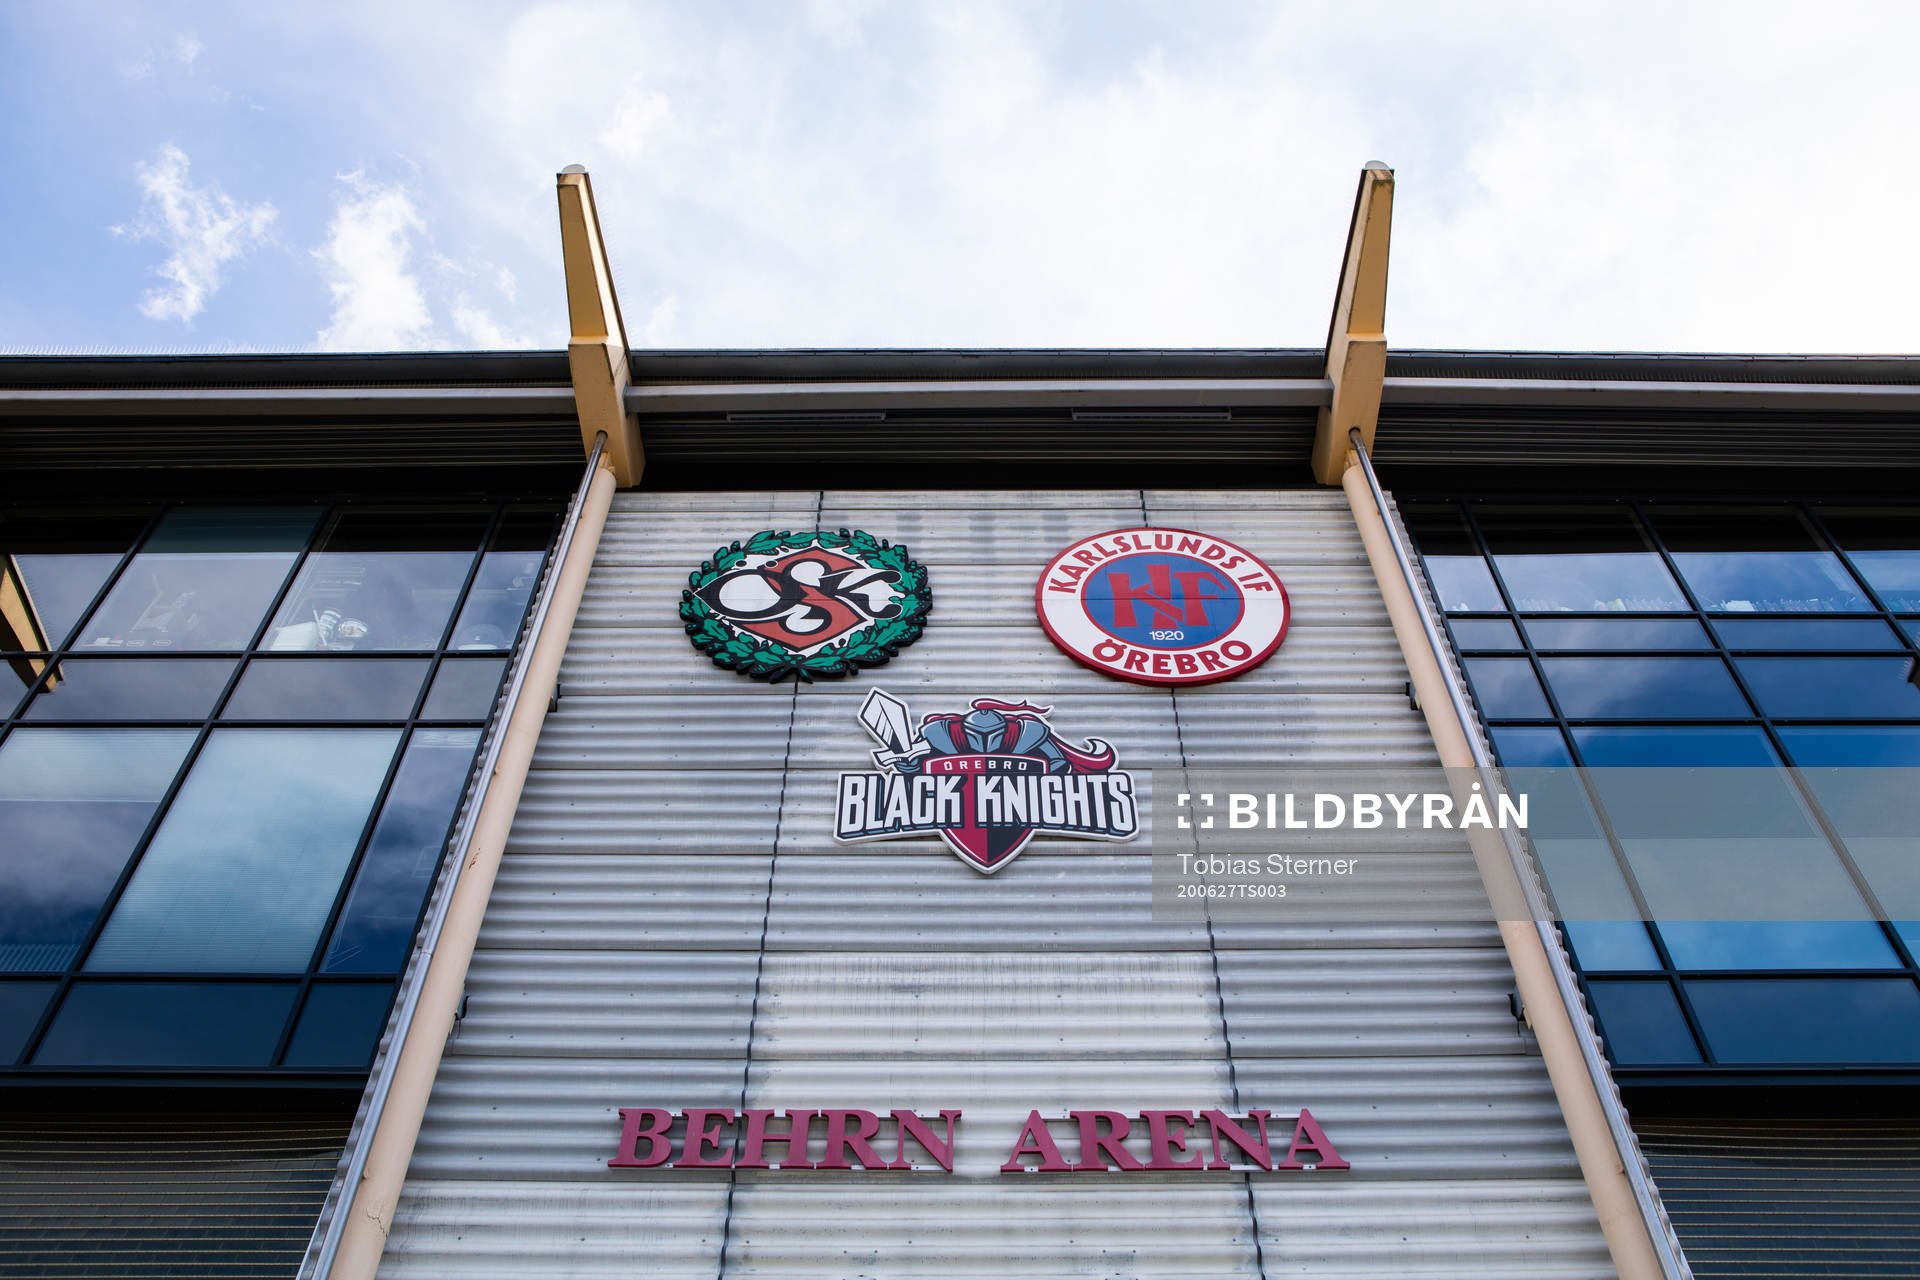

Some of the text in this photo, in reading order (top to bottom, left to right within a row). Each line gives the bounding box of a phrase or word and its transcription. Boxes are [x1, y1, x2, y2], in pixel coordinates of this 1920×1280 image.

[1048, 533, 1274, 594] KARLSLUNDS IF
[1092, 639, 1253, 676] ÖREBRO
[1149, 630, 1184, 642] 1920
[839, 771, 1137, 834] BLACK KNIGHTS
[608, 1107, 1351, 1173] BEHRN ARENA
